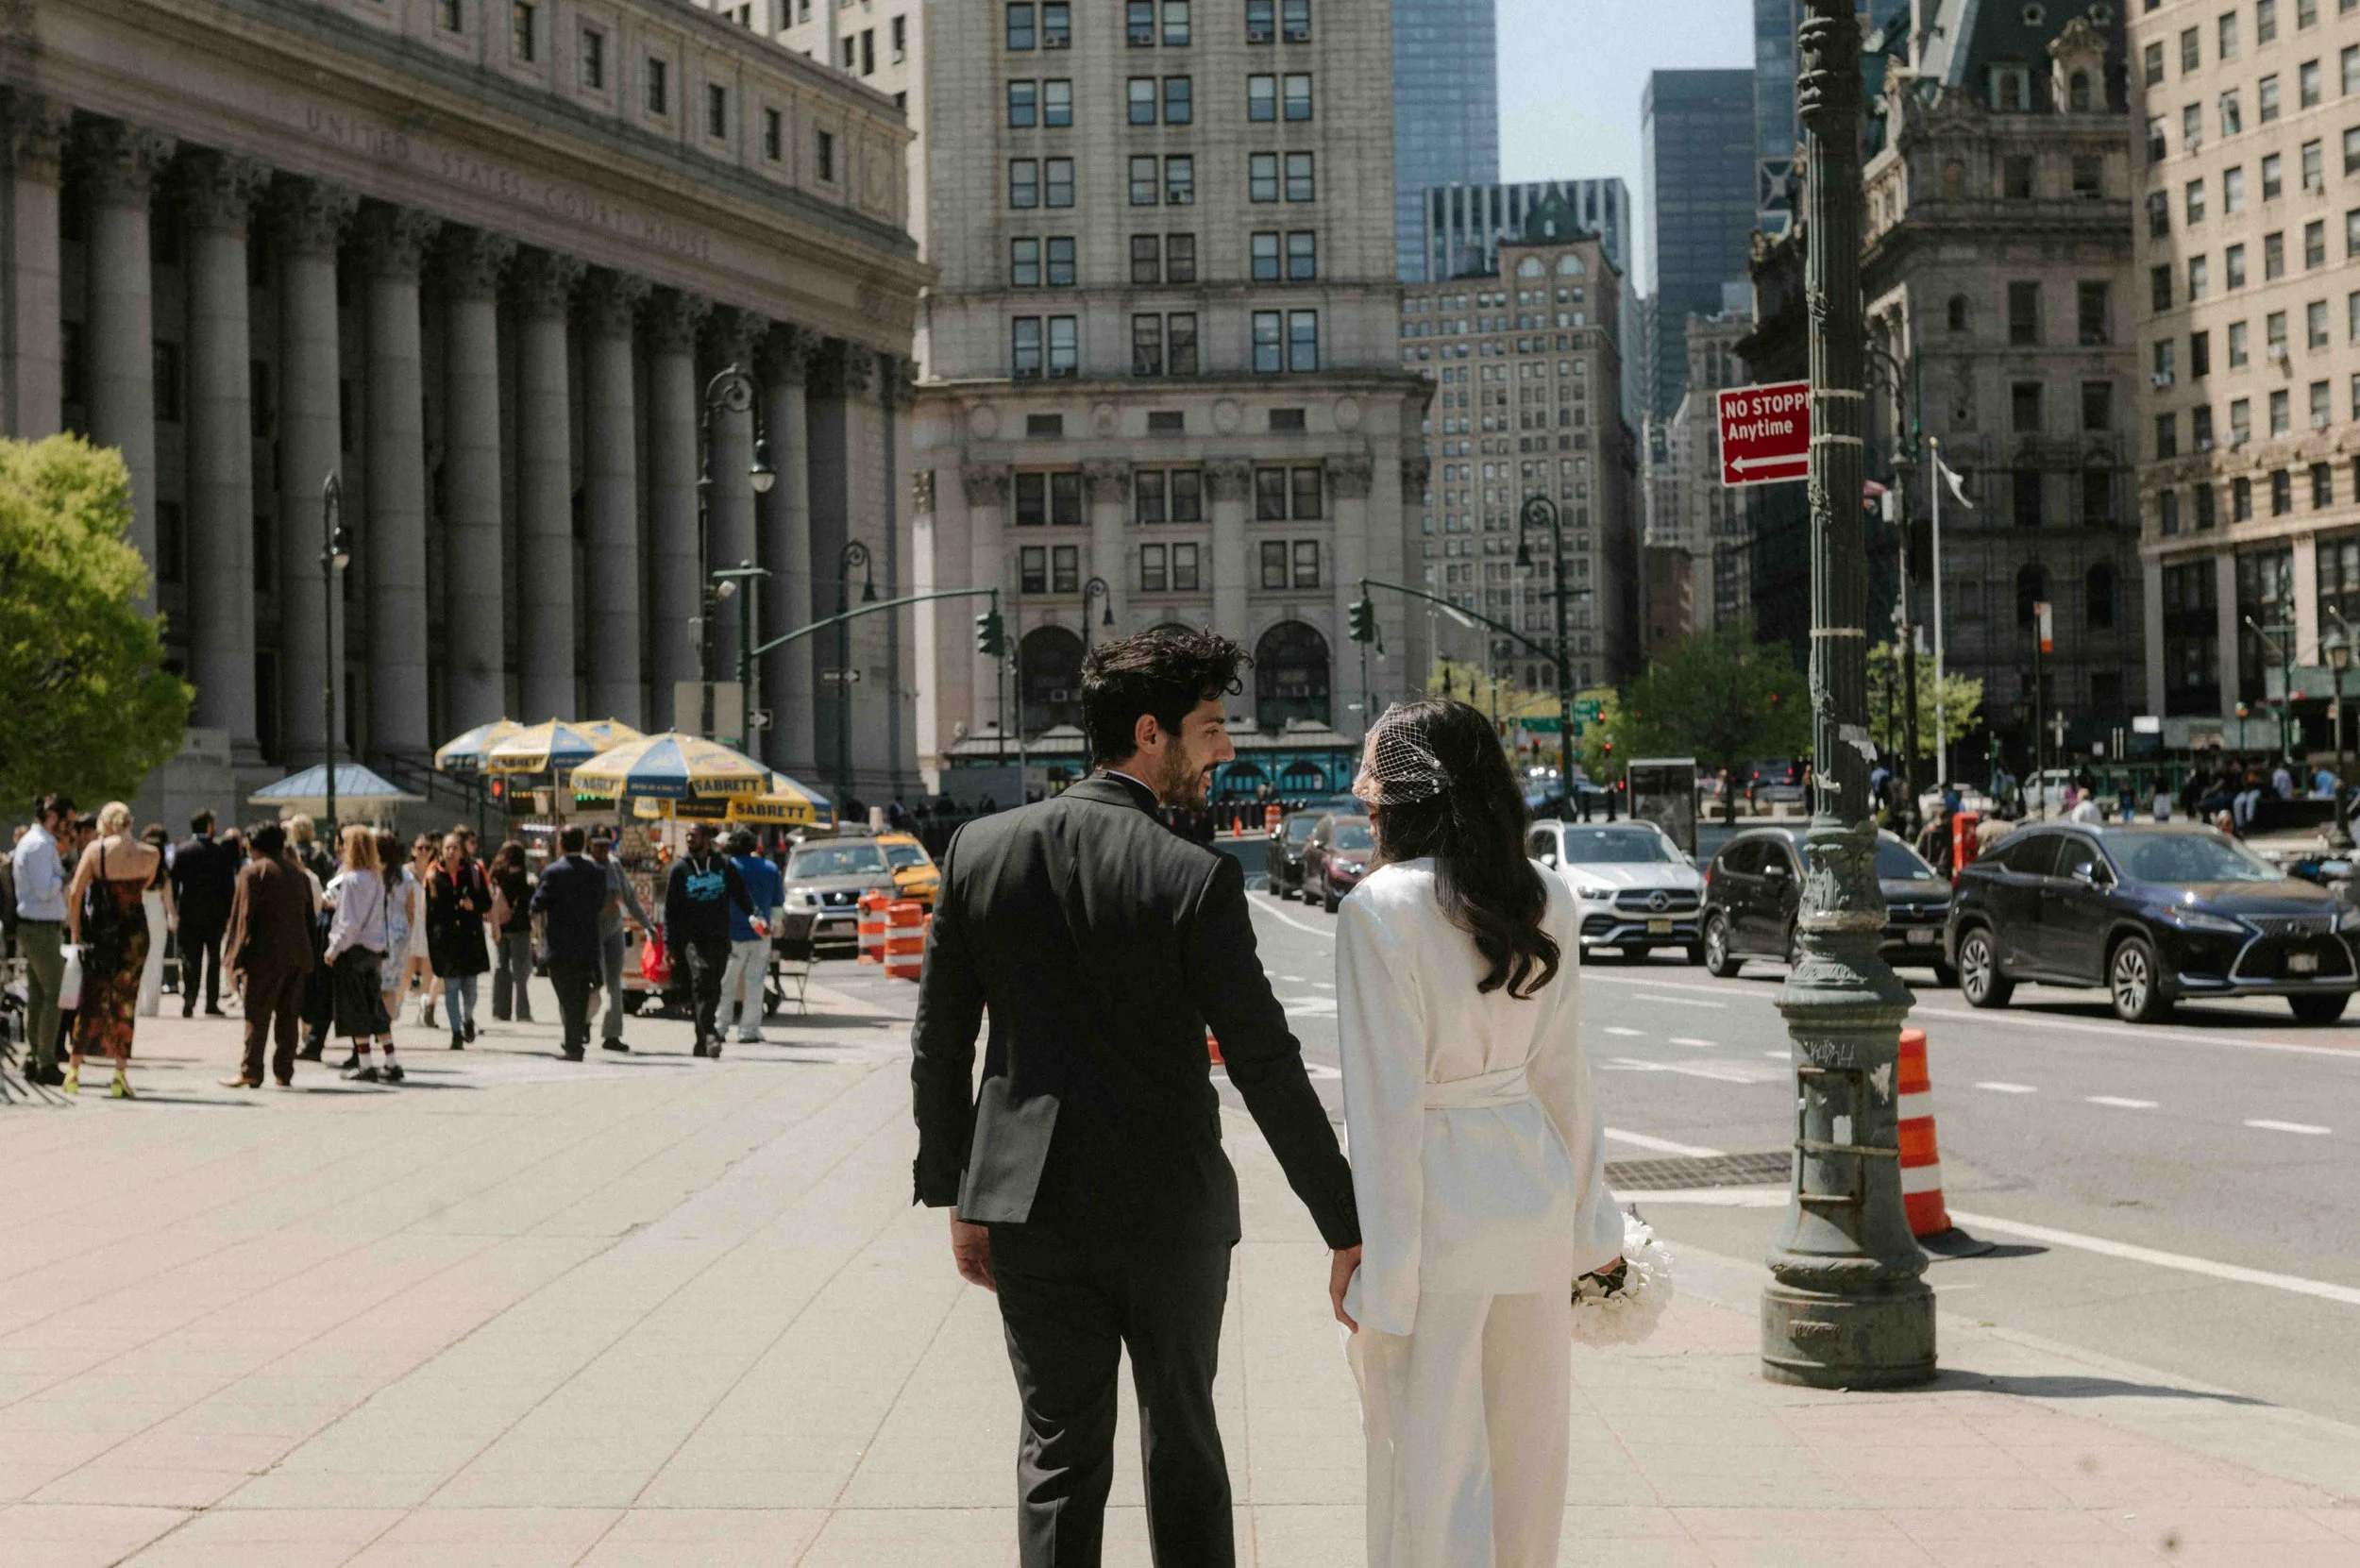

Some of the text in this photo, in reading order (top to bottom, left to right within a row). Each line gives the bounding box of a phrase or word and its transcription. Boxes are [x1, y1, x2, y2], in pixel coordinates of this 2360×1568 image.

[308, 106, 711, 261] UNITED STATES COURT HOUSE
[1725, 399, 1748, 419] NO
[1728, 419, 1793, 442] Anytime
[694, 779, 759, 792] SABRETT
[734, 802, 806, 819] SABRETT
